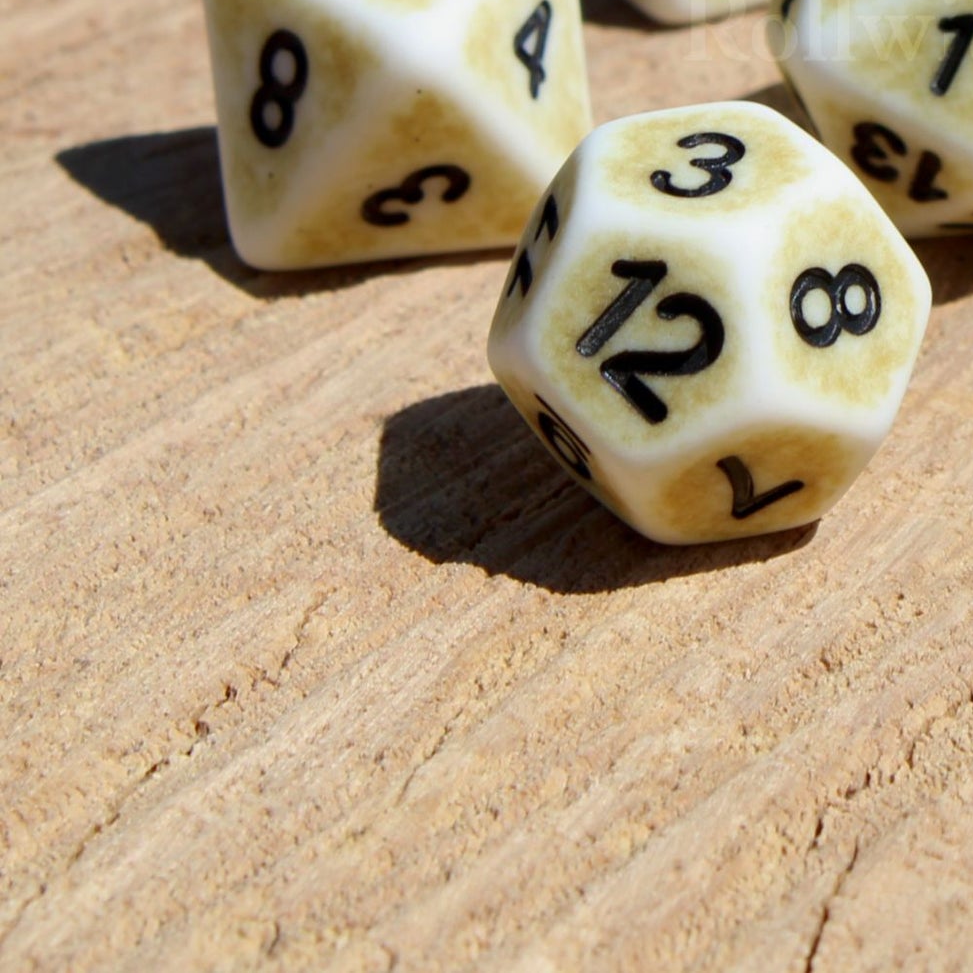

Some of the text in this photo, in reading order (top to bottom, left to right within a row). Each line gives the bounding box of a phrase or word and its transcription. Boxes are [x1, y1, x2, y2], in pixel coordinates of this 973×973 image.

[248, 29, 309, 149] 8
[514, 0, 551, 98] 4
[360, 164, 472, 228] 3
[649, 132, 746, 198] 3
[849, 120, 949, 203] 13
[575, 259, 726, 426] 12
[789, 263, 882, 348] 8
